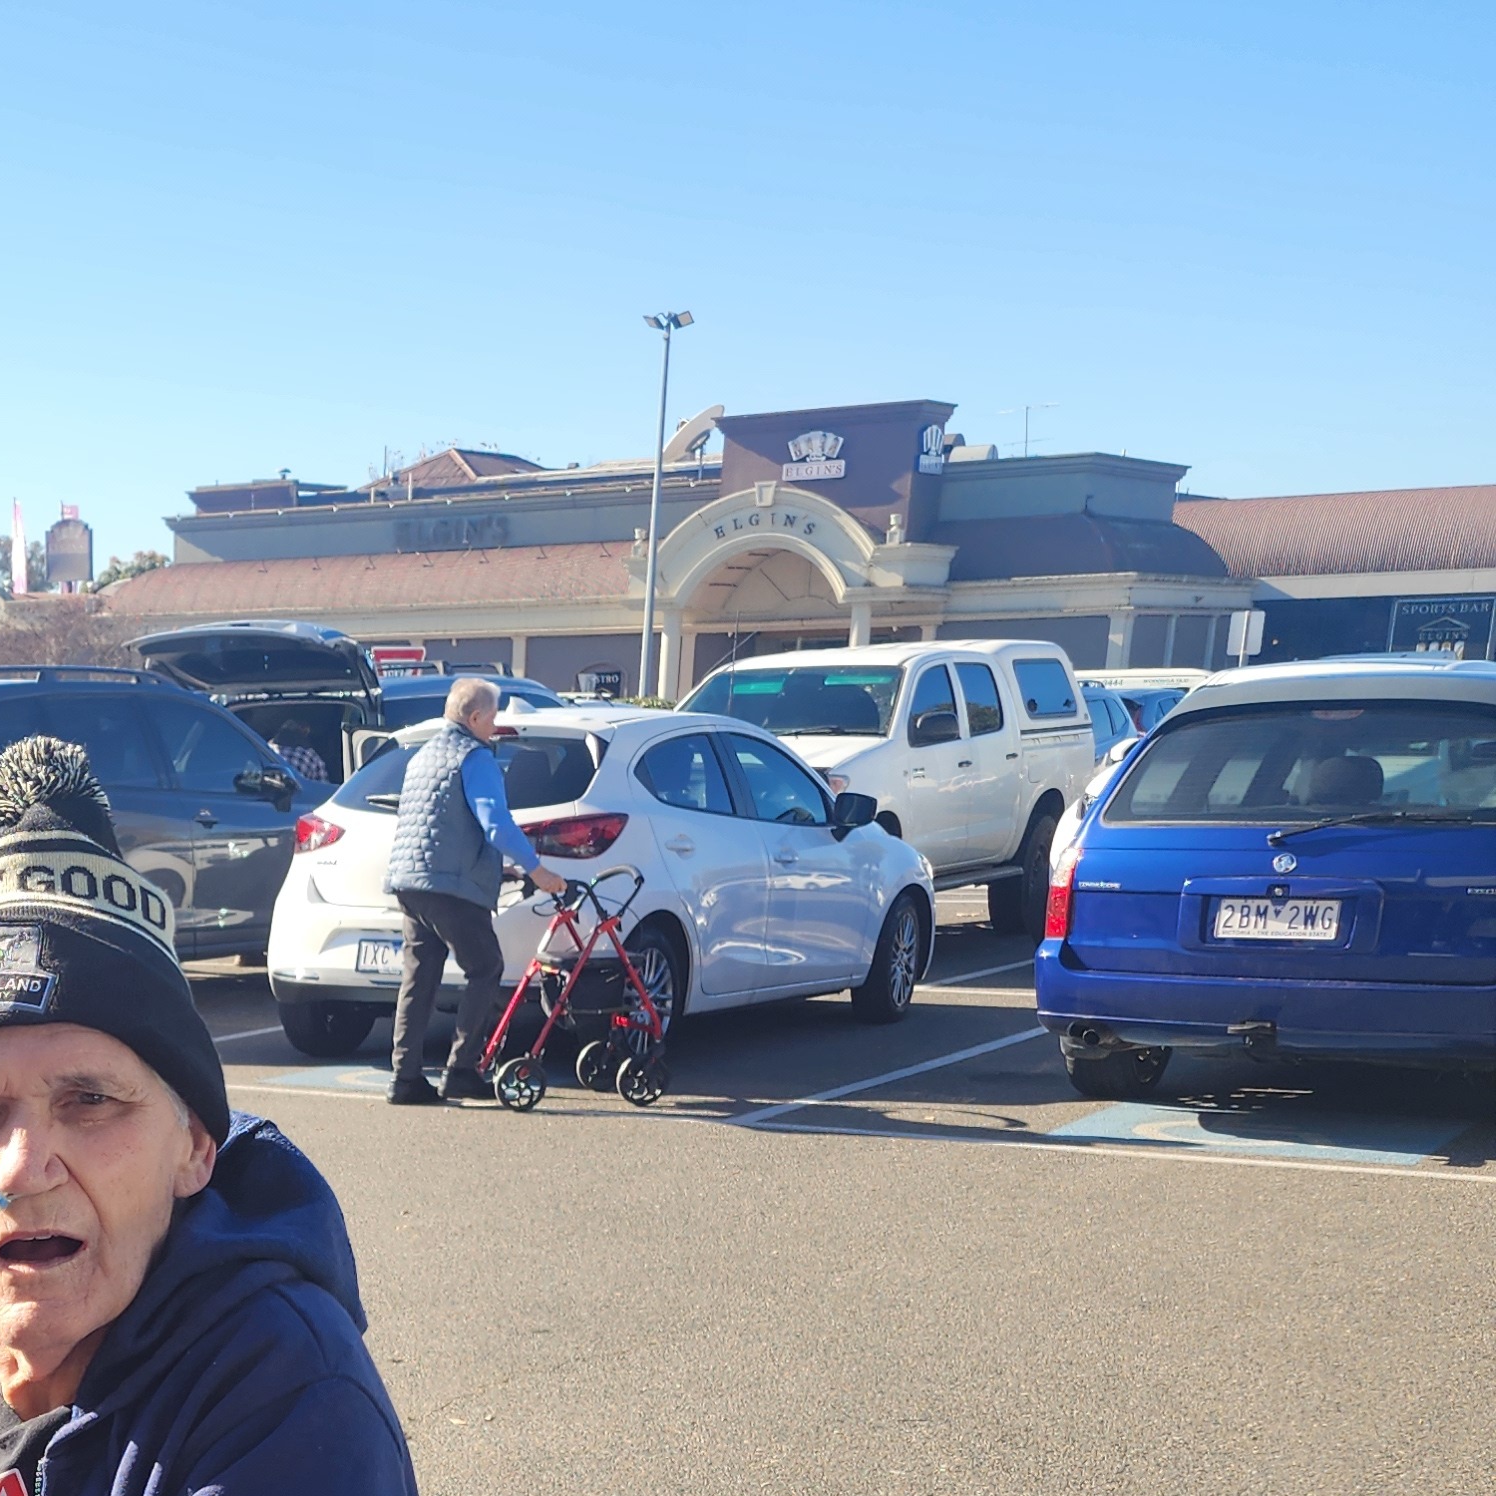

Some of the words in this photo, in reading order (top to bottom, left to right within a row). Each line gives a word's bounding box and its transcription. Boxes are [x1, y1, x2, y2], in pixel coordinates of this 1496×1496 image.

[785, 463, 843, 478] ELGIN'S
[713, 511, 818, 541] ELGIN'S
[1401, 603, 1456, 615] SPORTS
[1459, 602, 1490, 613] BAR
[16, 865, 168, 931] GOOD
[1223, 904, 1270, 930] 2BM
[1287, 905, 1334, 930] 2WG
